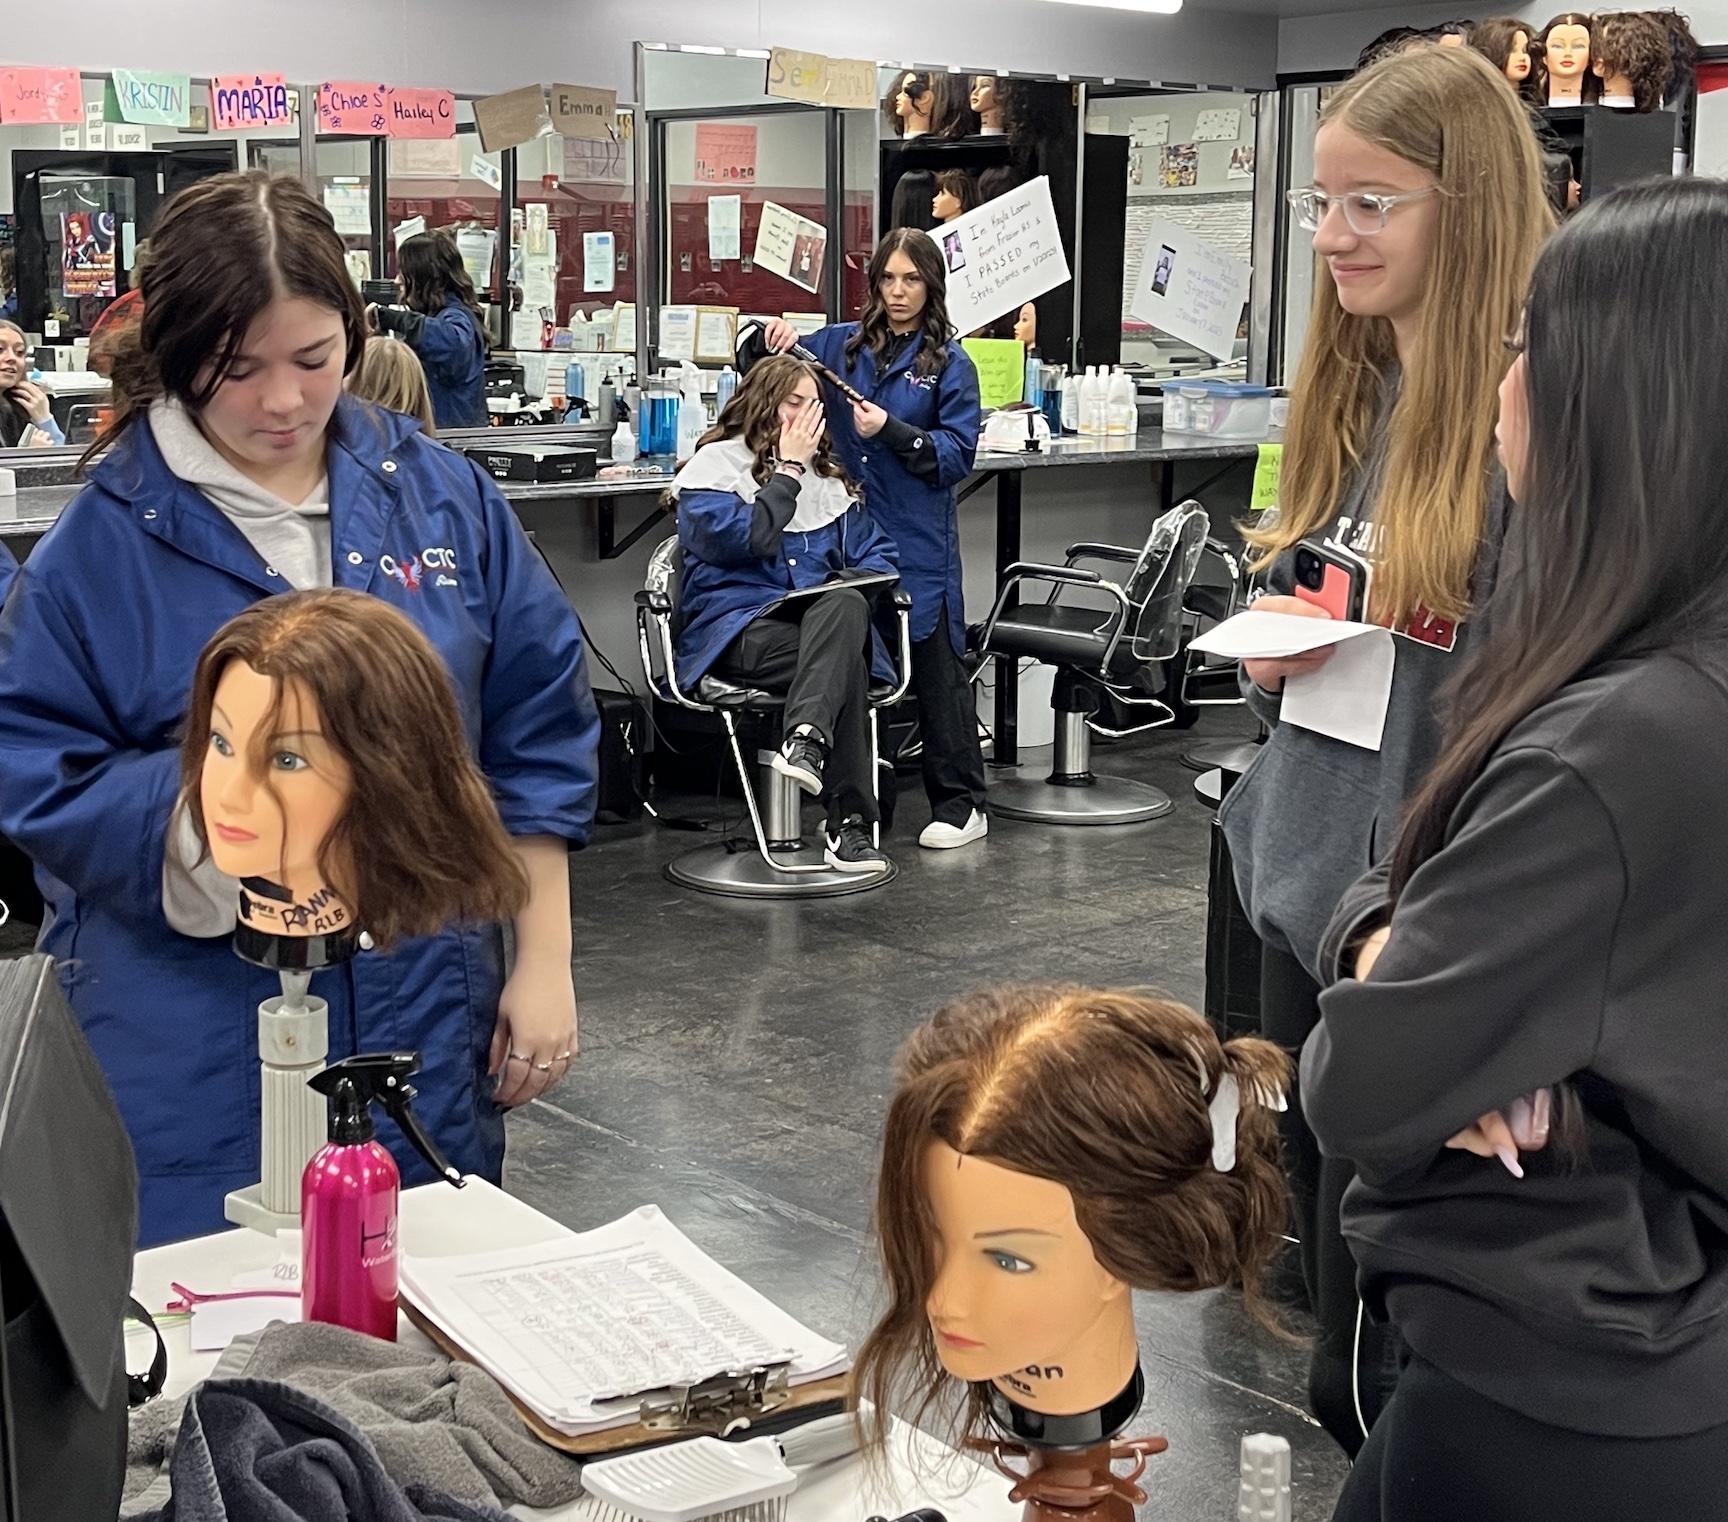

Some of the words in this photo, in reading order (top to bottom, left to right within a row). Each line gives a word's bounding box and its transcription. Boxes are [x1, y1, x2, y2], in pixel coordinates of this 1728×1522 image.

[119, 79, 183, 112] KRISTIN
[218, 85, 288, 121] MARIA
[331, 91, 369, 111] Chloe
[373, 93, 383, 108] S
[559, 94, 603, 116] Emma
[393, 101, 435, 125] Hailey
[438, 98, 450, 118] C
[964, 273, 973, 289] I
[978, 246, 1023, 279] PASSED
